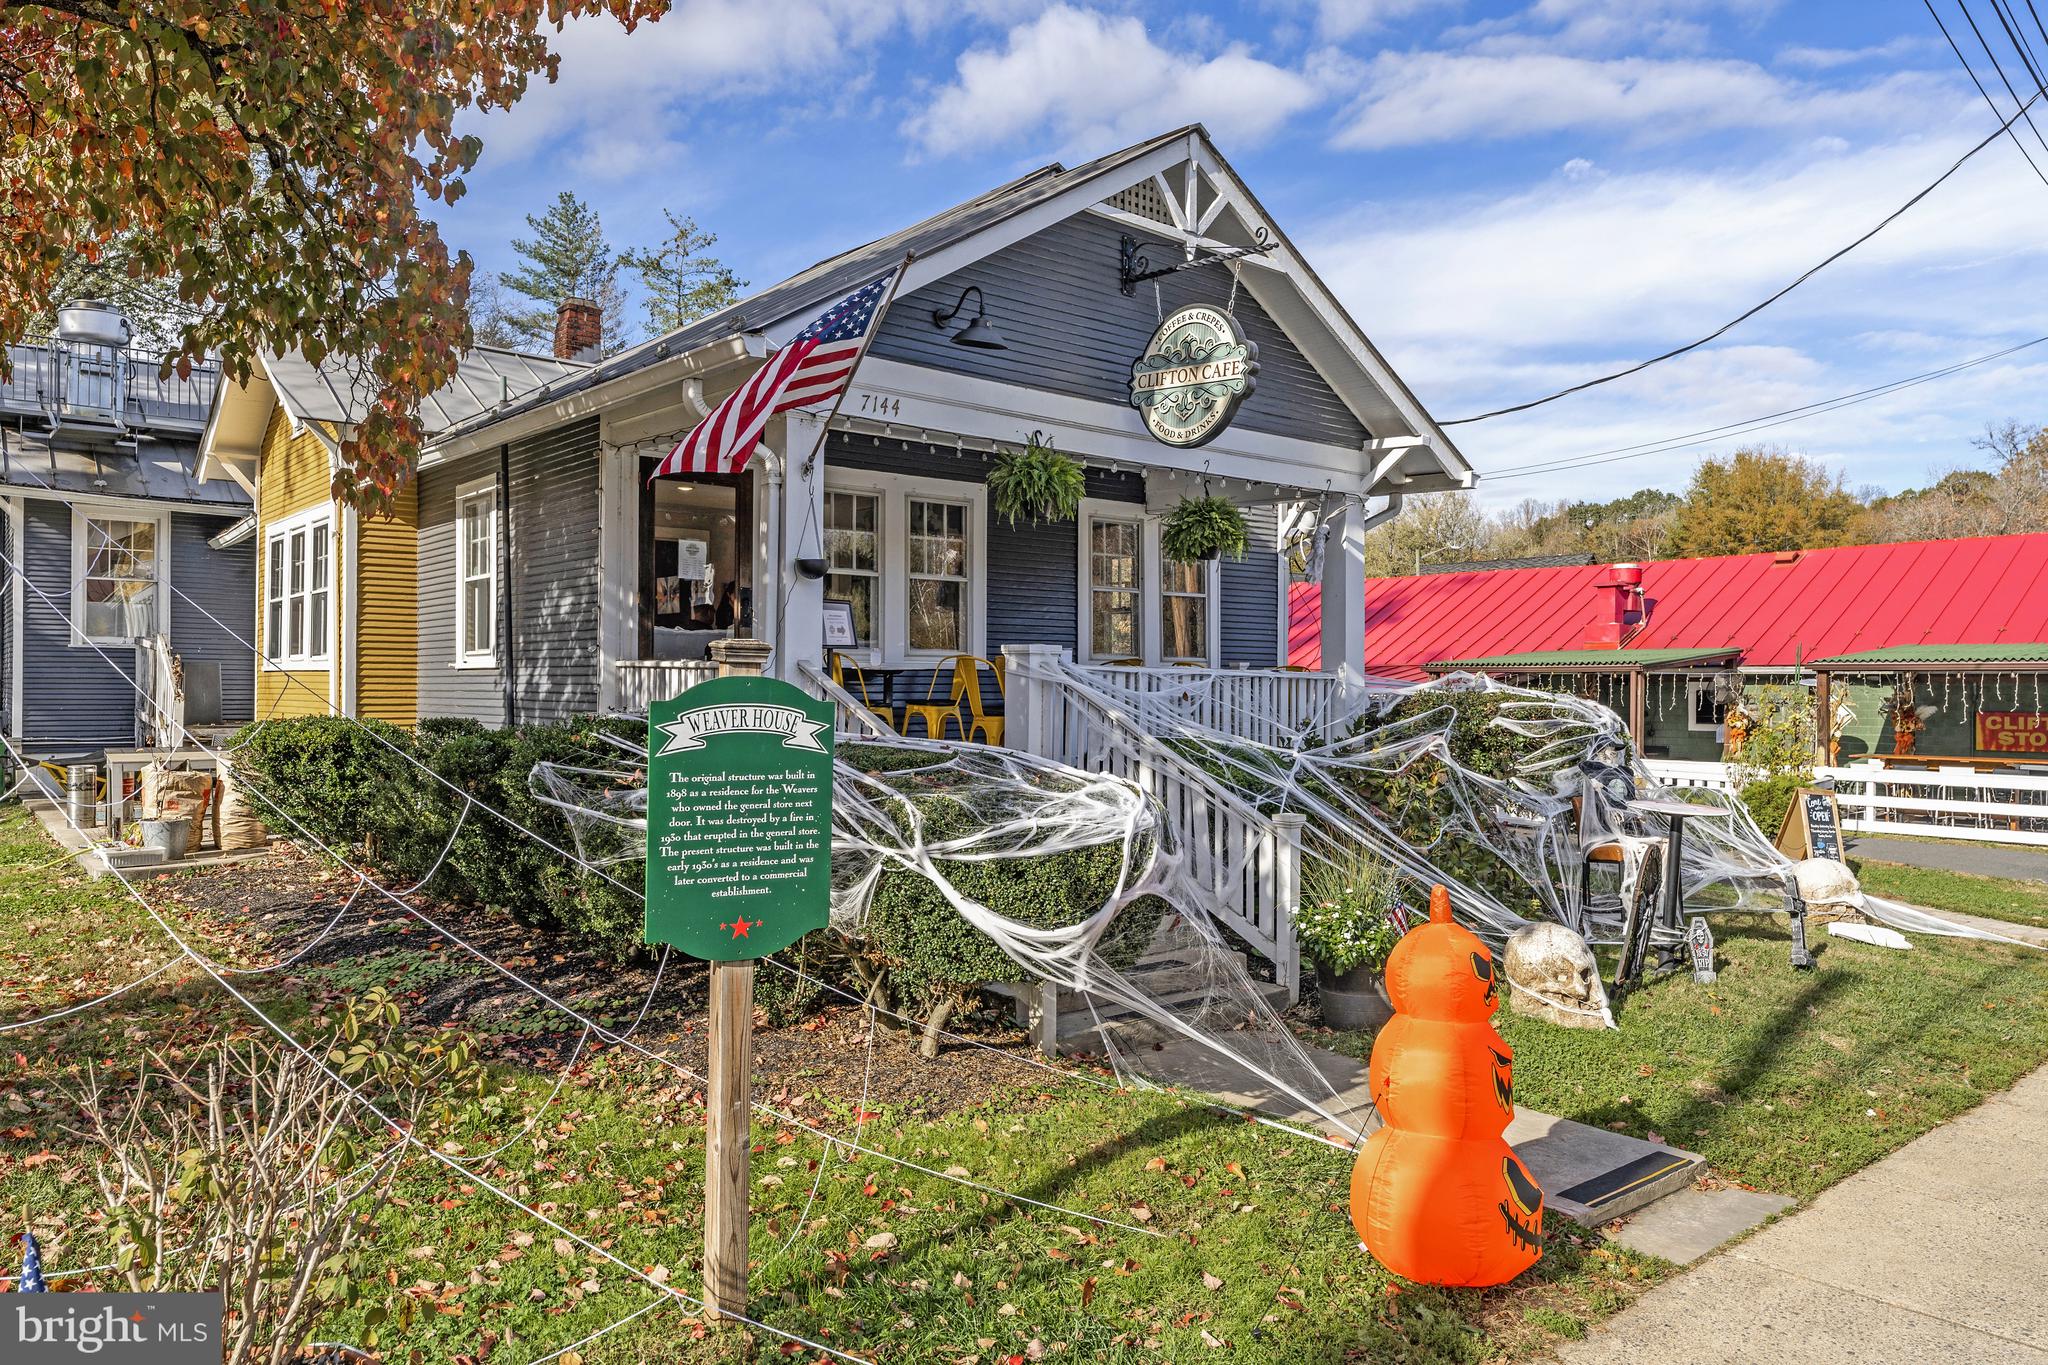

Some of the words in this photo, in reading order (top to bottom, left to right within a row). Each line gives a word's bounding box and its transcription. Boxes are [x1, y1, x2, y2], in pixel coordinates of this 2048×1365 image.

[1157, 314, 1187, 342] COFFEE
[1195, 311, 1224, 333] CREPES
[1138, 366, 1200, 389] CLIFTON
[1201, 360, 1241, 380] CAFE
[861, 394, 900, 417] 7144
[1155, 420, 1176, 439] FOOD
[1185, 412, 1216, 438] DRINKS
[686, 709, 749, 734] WEAVER
[752, 708, 801, 735] HOUSE
[669, 772, 689, 783] The
[691, 771, 726, 785] original
[727, 773, 765, 782] structure
[785, 769, 805, 780] built
[806, 770, 815, 780] in
[666, 788, 687, 800] 1898
[709, 785, 749, 797] residence
[751, 785, 764, 795] for
[765, 785, 780, 795] the
[781, 783, 818, 794] Weavers
[671, 801, 691, 813] who
[693, 800, 722, 811] owned
[724, 800, 738, 810] the
[739, 798, 771, 813] general
[772, 799, 793, 808] store
[795, 799, 813, 808] next
[669, 817, 693, 827] door.
[695, 815, 706, 826] It
[726, 813, 767, 827] destroyed
[769, 813, 780, 825] by
[789, 811, 804, 822] fire
[805, 812, 814, 821] in
[1812, 811, 1830, 822] OPEN
[660, 832, 681, 845] 1930
[683, 831, 701, 841] that
[704, 829, 737, 842] erupted
[739, 829, 748, 838] in
[750, 827, 764, 838] the
[765, 827, 796, 841] general
[797, 828, 821, 836] store.
[659, 846, 680, 858] The
[681, 848, 714, 859] present
[716, 845, 754, 854] structure
[774, 840, 794, 851] built
[795, 841, 804, 850] in
[805, 839, 819, 849] the
[667, 861, 690, 874] early
[692, 859, 719, 873] 1930's
[740, 857, 779, 867] residence
[780, 855, 797, 865] and
[674, 875, 694, 886] later
[697, 872, 739, 885] converted
[741, 873, 750, 882] to
[760, 868, 808, 880] commercial
[711, 886, 772, 898] establishment.
